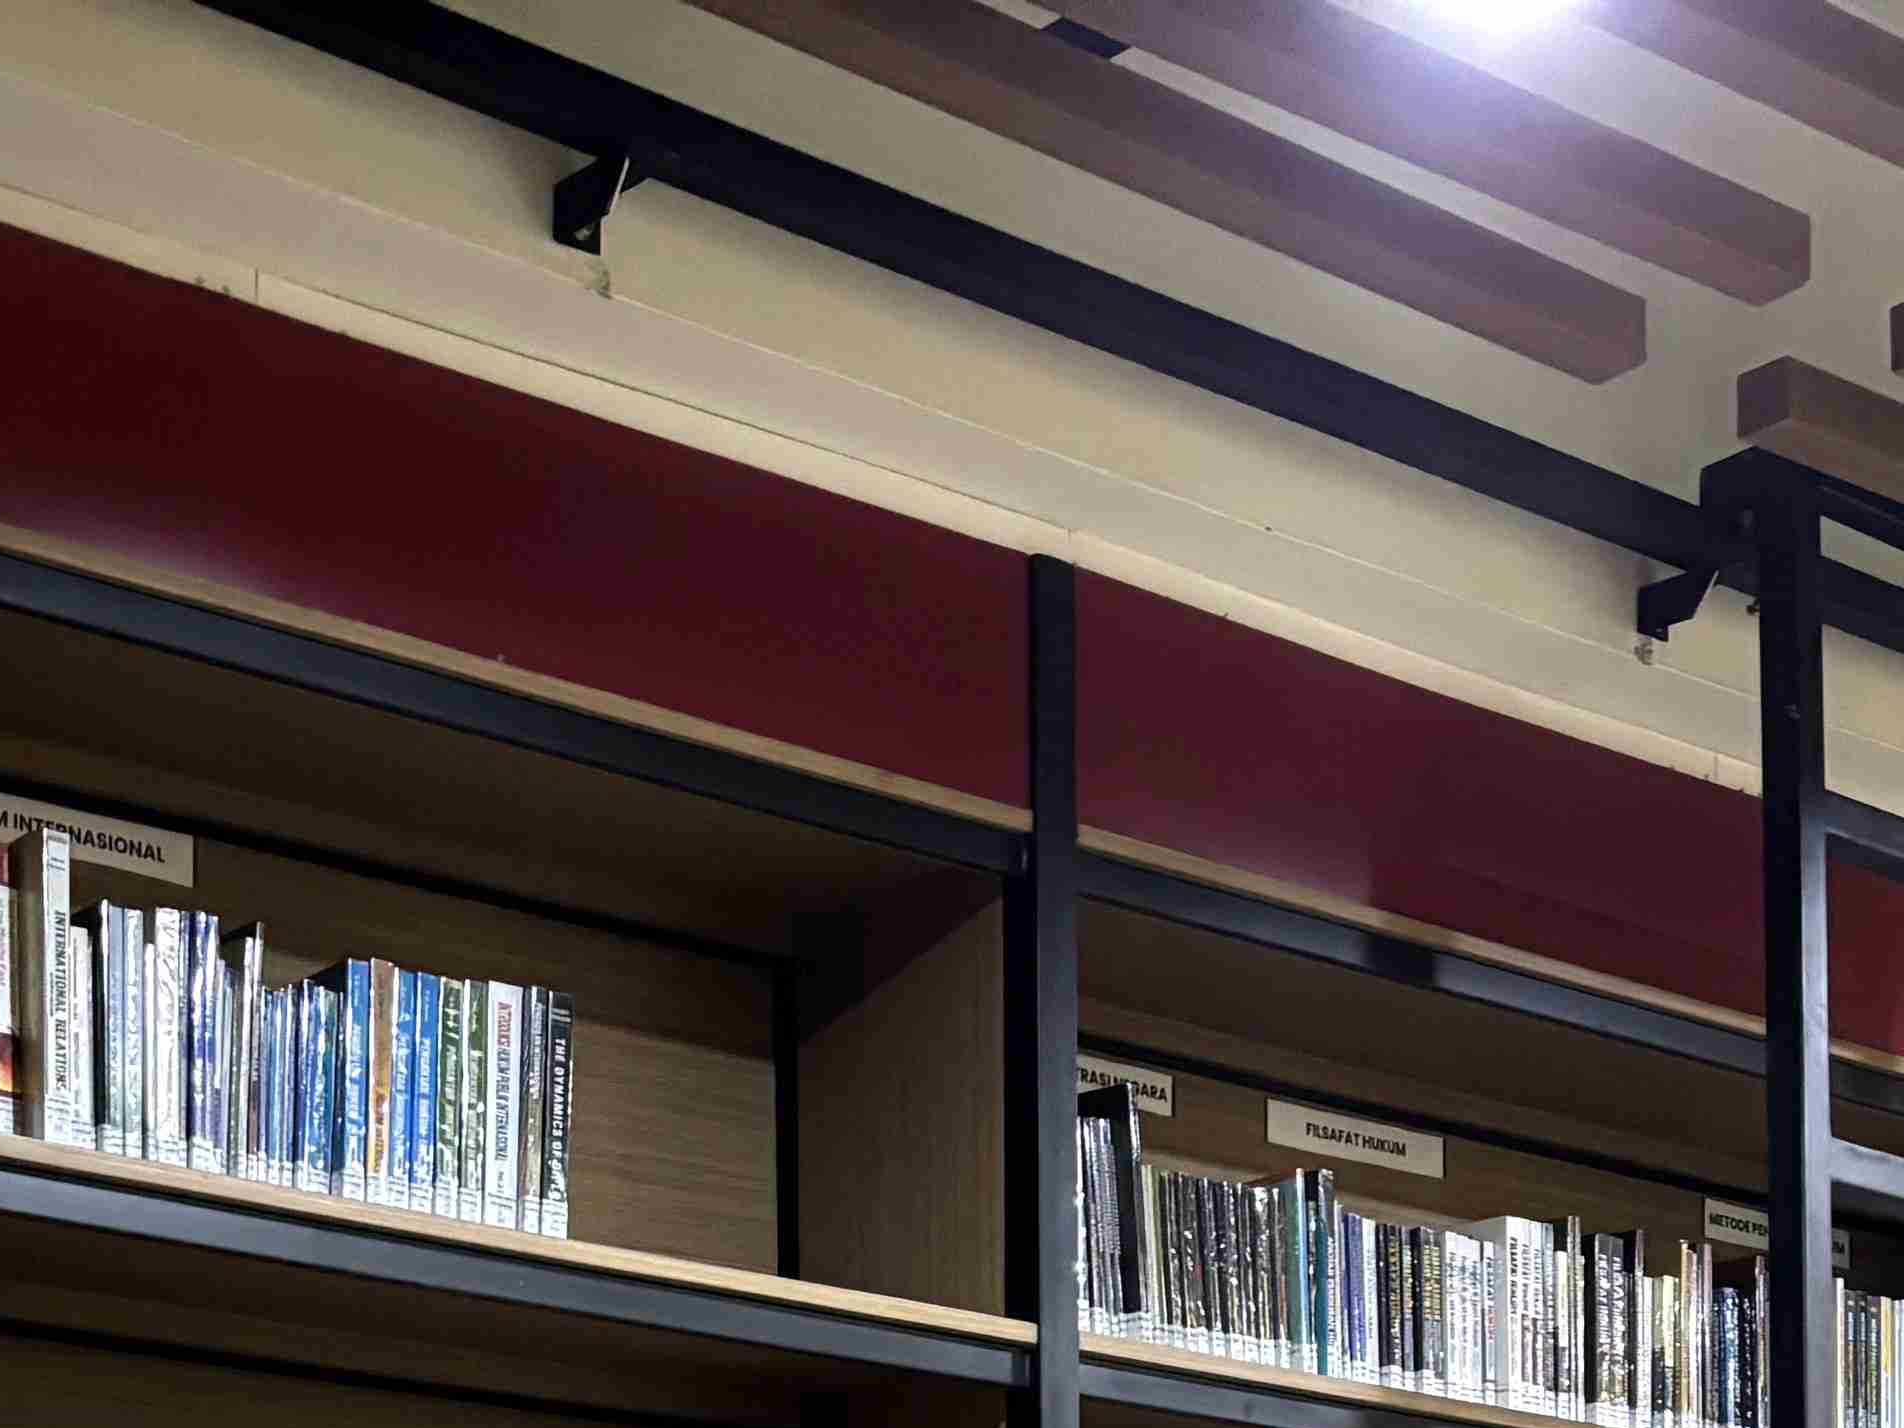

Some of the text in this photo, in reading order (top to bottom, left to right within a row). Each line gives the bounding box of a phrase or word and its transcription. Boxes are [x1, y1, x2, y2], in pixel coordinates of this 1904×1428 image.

[54, 911, 67, 1090] INTERNATIONAL RELATIONS
[554, 1038, 566, 1061] THE
[551, 1065, 566, 1137] DYNAMICS
[1305, 1121, 1407, 1157] FILSAFAT HUKUM
[1708, 1211, 1751, 1235] METODE
